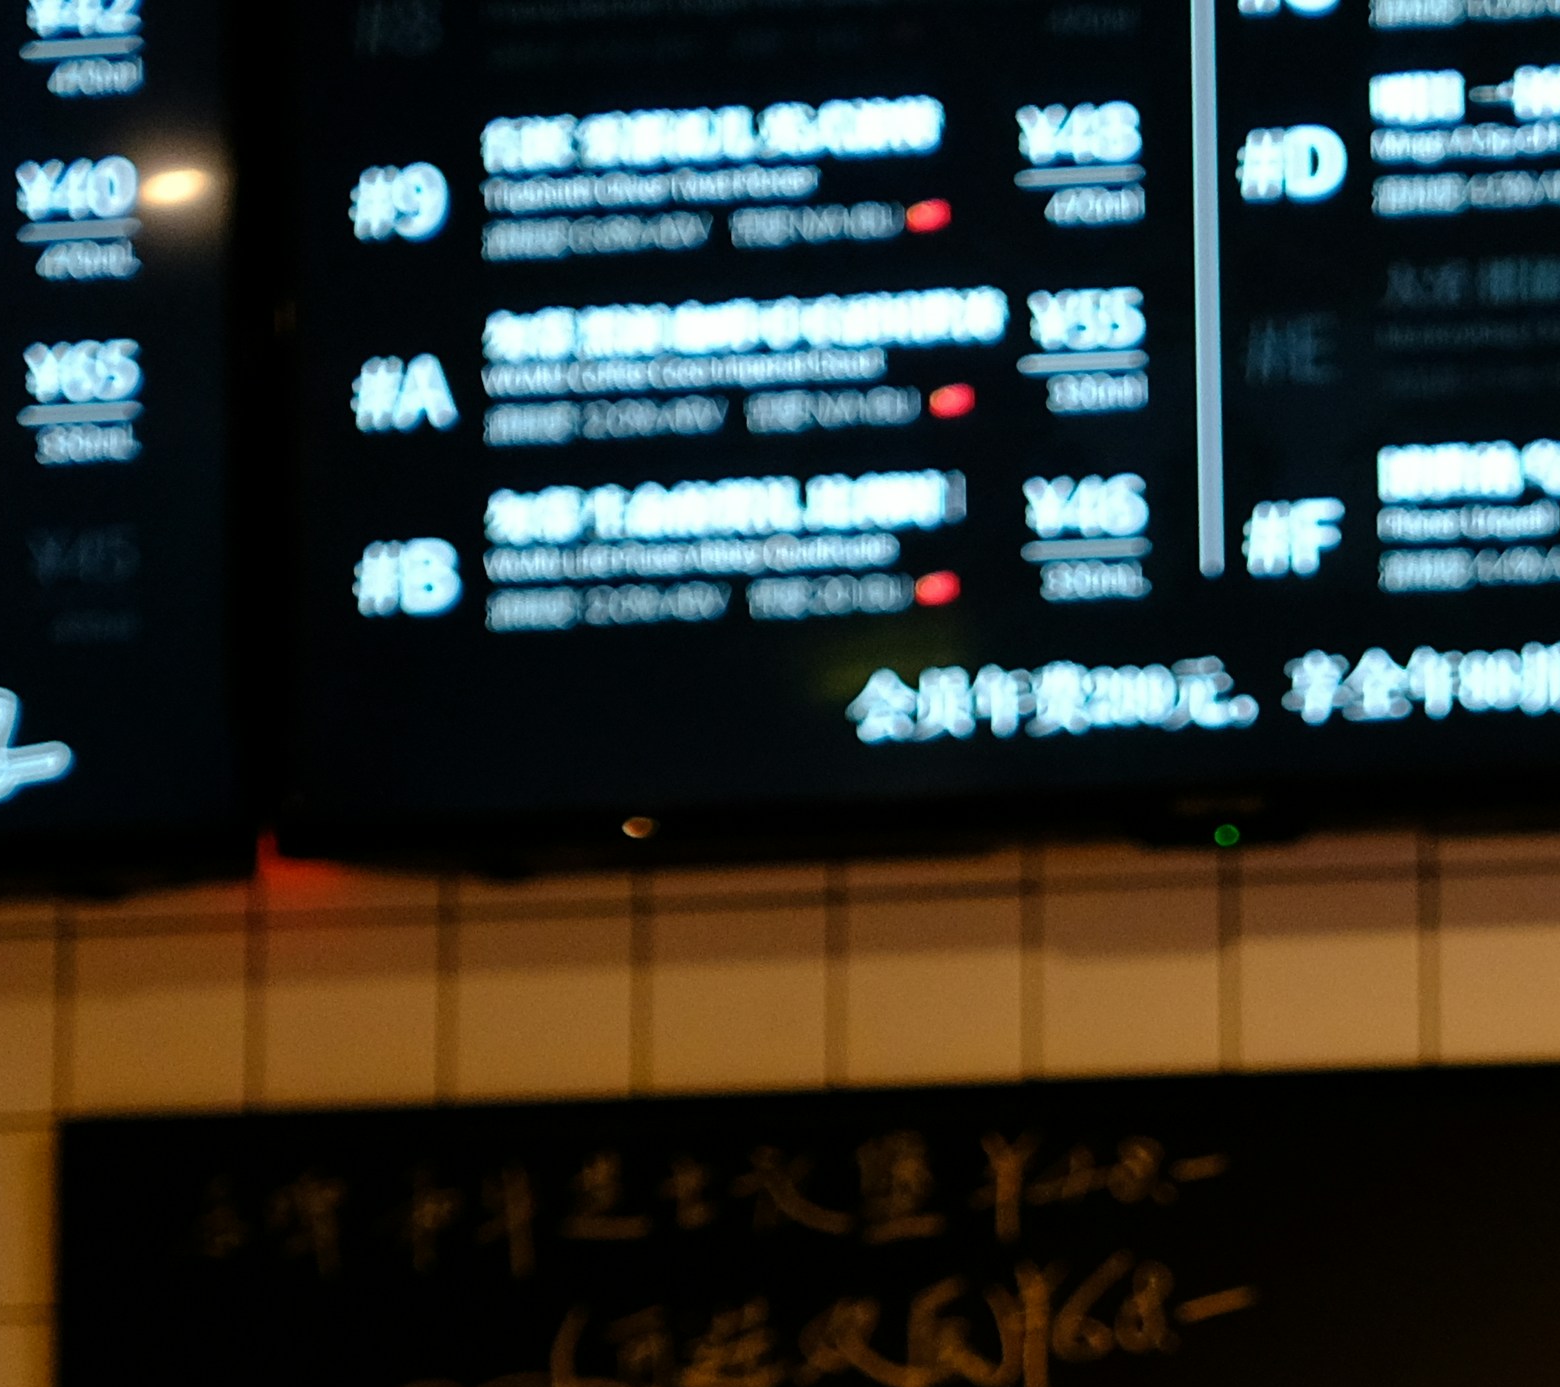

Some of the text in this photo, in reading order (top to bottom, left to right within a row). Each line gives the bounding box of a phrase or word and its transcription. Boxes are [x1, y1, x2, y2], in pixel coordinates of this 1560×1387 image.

[349, 162, 449, 240] #9
[351, 354, 458, 431] #A
[353, 538, 461, 615] #B
